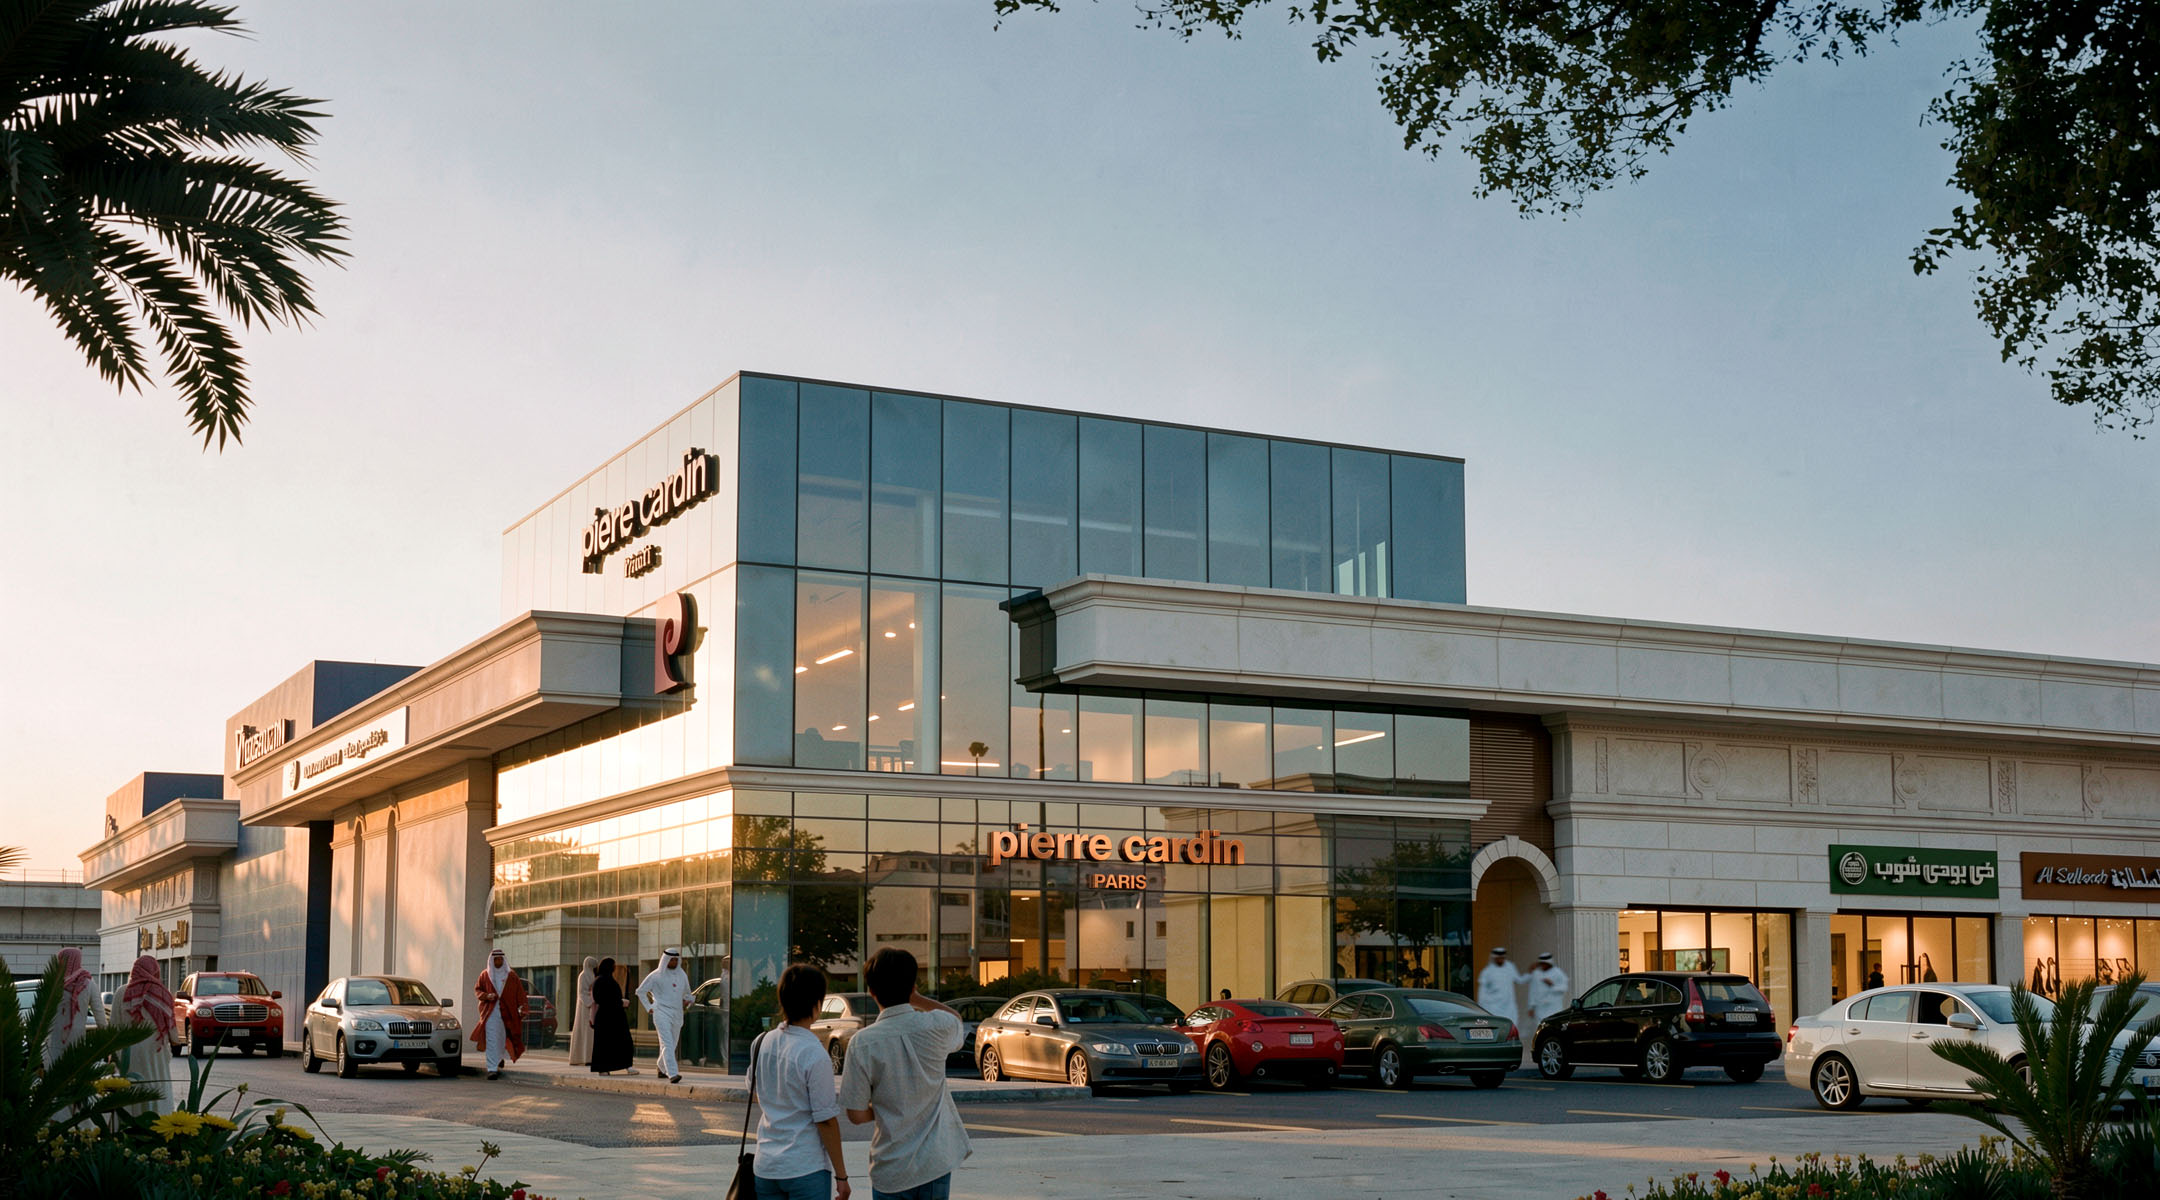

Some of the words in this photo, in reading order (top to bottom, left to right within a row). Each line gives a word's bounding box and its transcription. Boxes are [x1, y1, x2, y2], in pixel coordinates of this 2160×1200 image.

[989, 823, 1113, 866] pierre
[1122, 829, 1245, 865] cardin
[1093, 873, 1147, 890] PARIS
